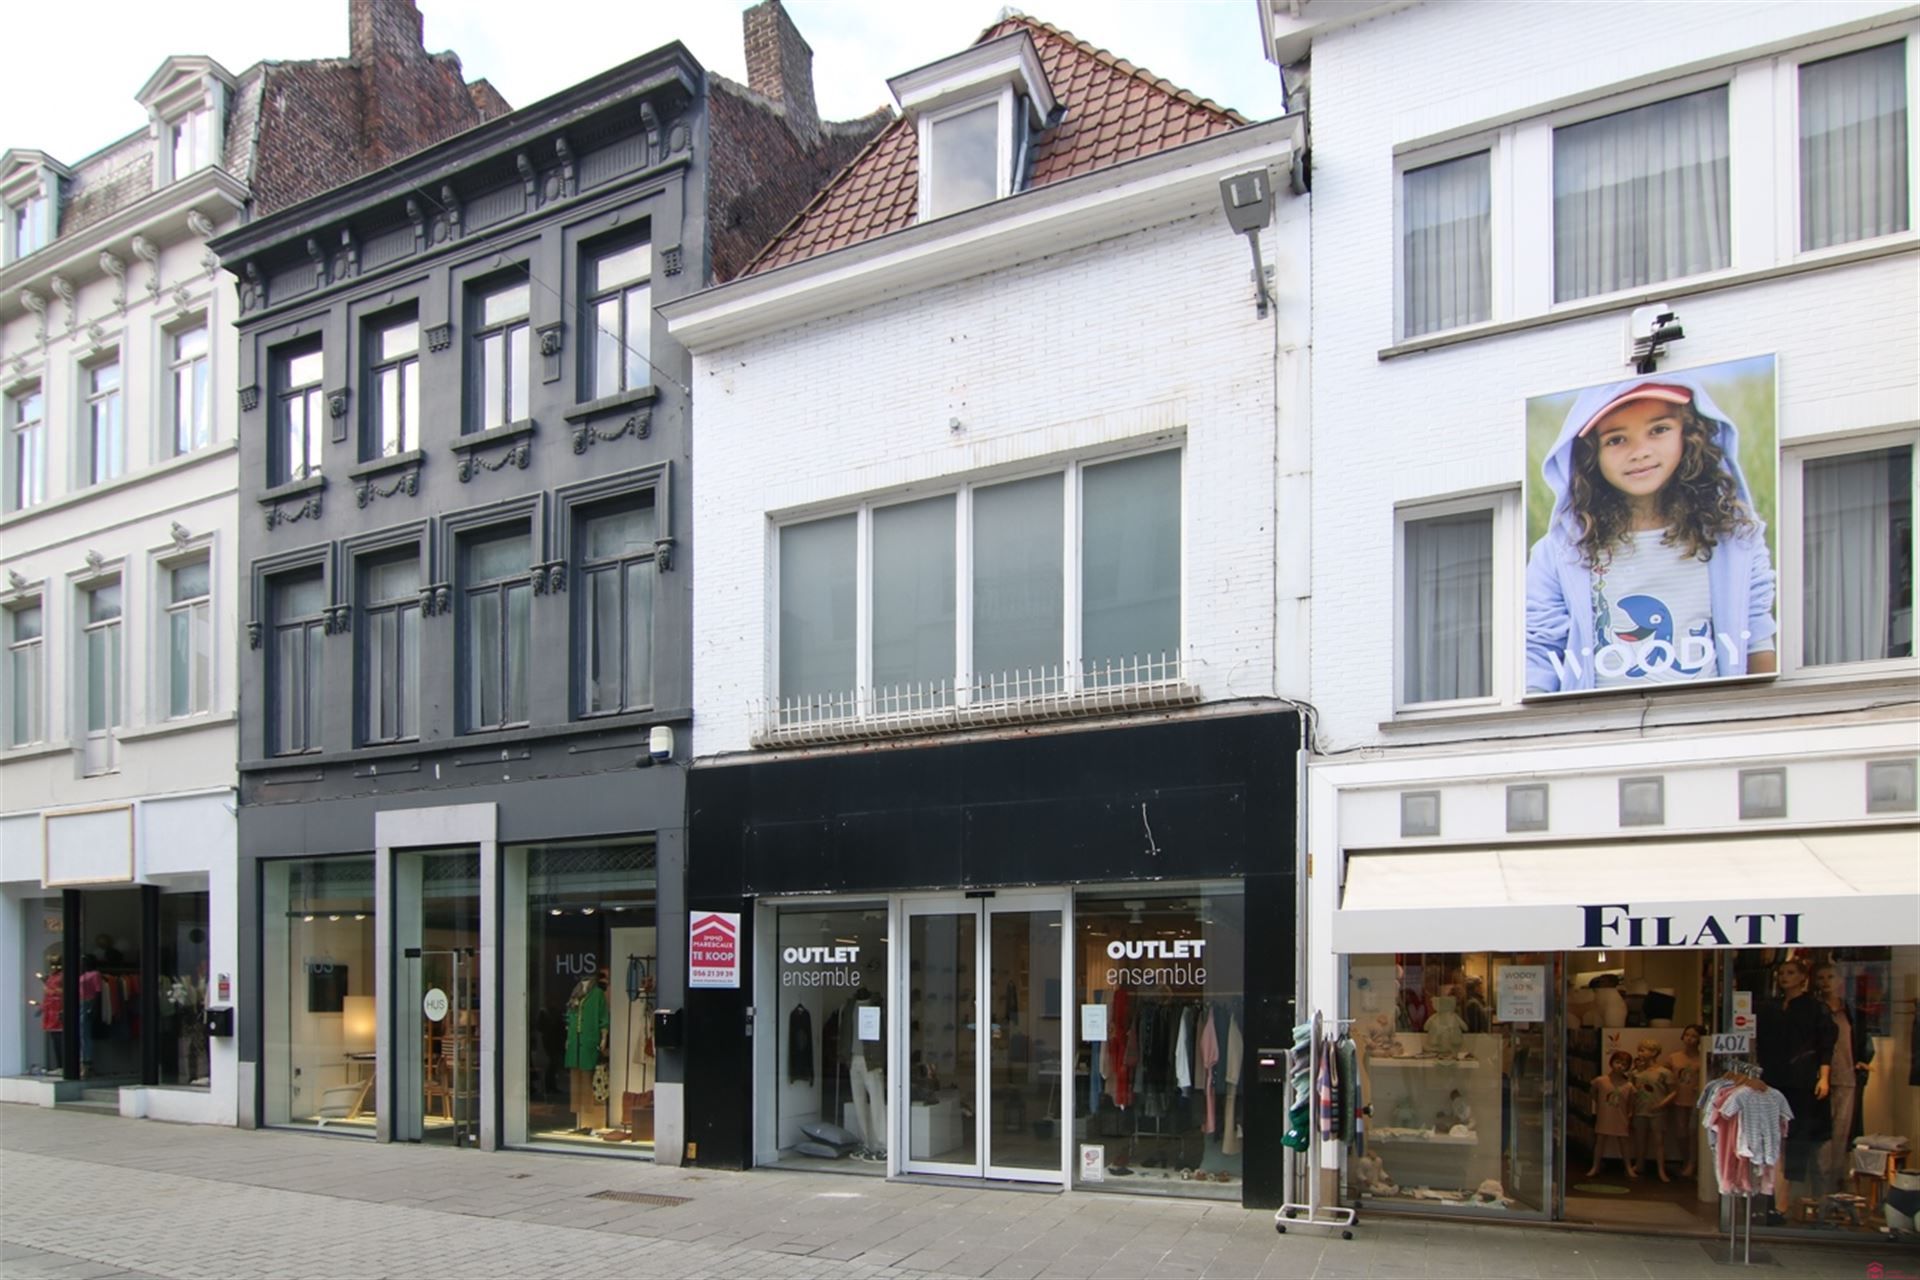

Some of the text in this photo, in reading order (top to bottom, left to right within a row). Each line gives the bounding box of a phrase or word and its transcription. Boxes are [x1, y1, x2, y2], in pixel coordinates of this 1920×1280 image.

[1546, 630, 1751, 682] WOODY
[693, 951, 735, 961] TE KOOP
[783, 946, 860, 964] OUTLET
[1107, 940, 1206, 960] OUTLET
[556, 952, 597, 975] HUS
[783, 966, 860, 987] ensemble
[1106, 963, 1207, 986] ensemble
[426, 999, 446, 1010] HUS
